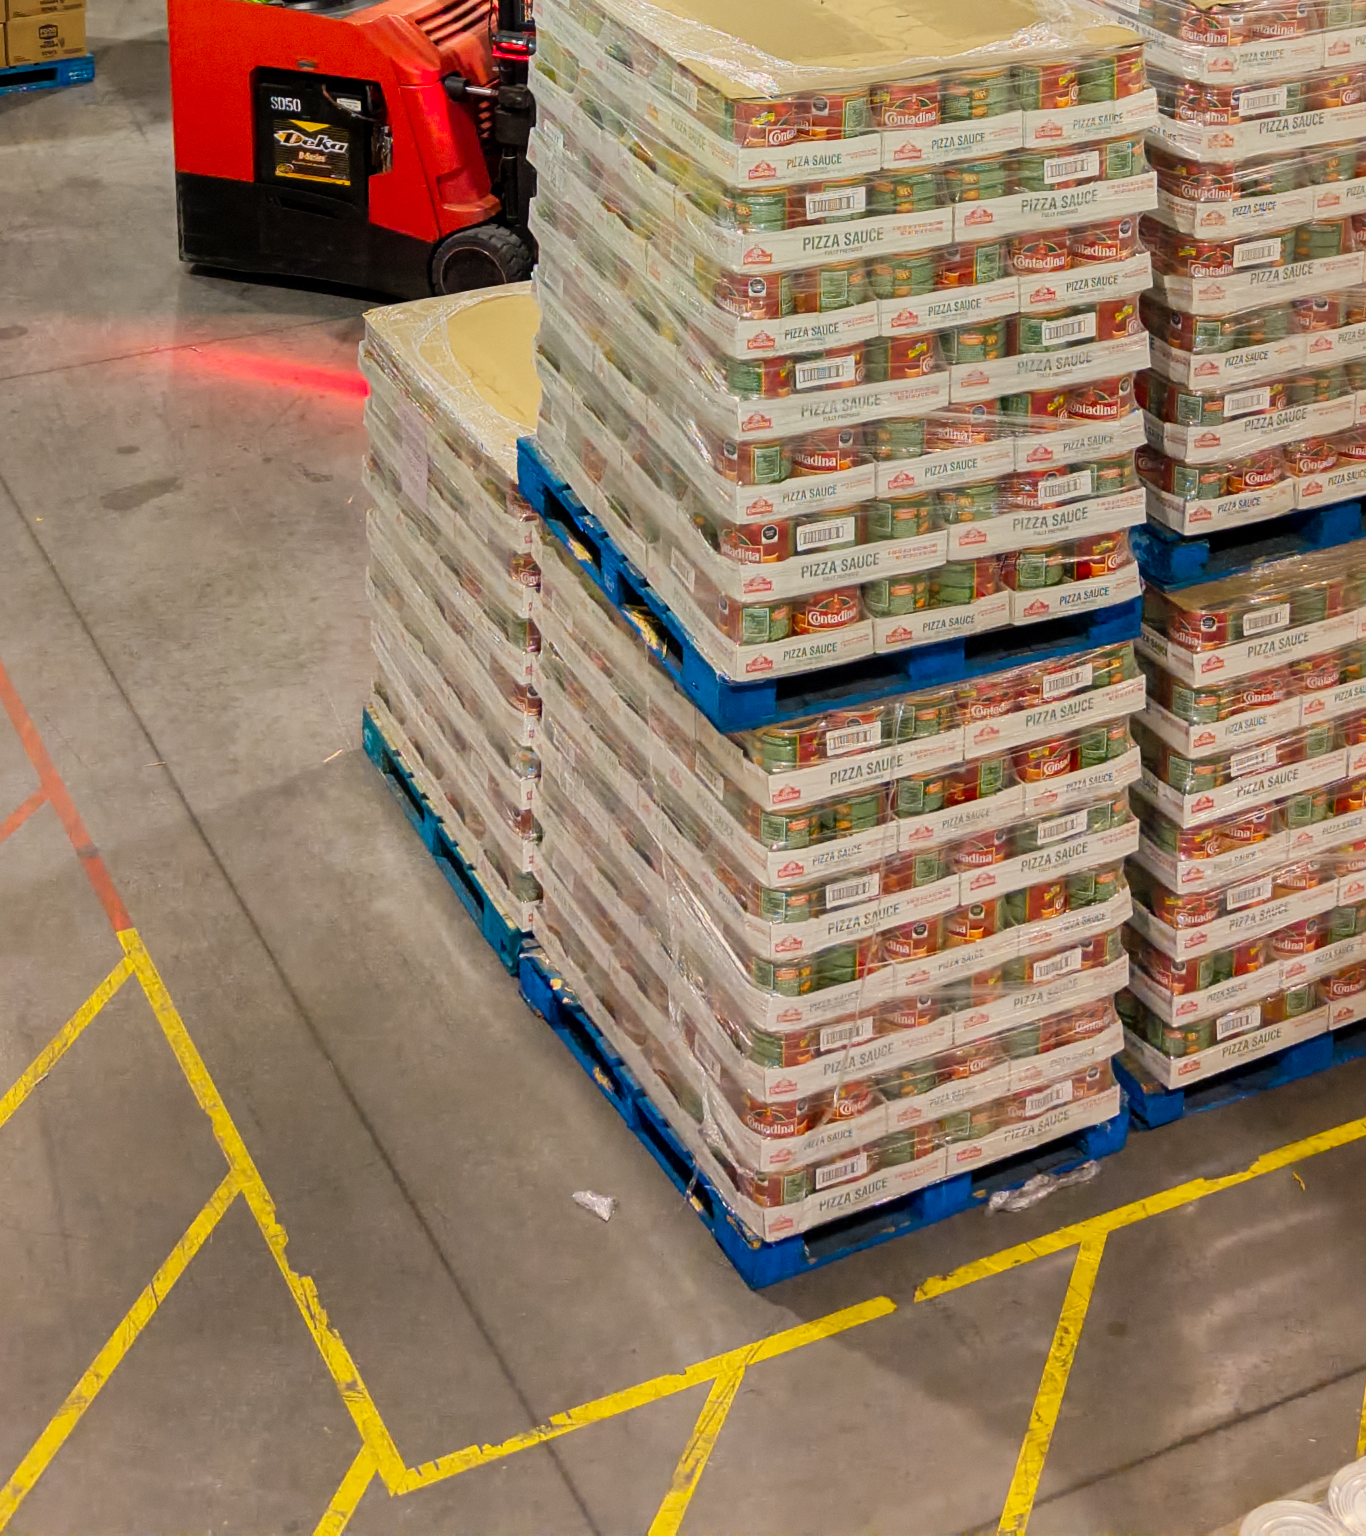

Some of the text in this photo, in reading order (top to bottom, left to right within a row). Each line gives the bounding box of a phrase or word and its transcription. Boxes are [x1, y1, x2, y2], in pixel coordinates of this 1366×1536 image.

[270, 95, 301, 112] SD50
[885, 111, 936, 126] Contadina
[1259, 112, 1324, 133] PIZZA SAUCE
[274, 129, 349, 153] Deka
[931, 132, 985, 150] PIZZA SAUCE
[787, 152, 842, 169] PIZZA SAUCE
[1021, 190, 1098, 212] PIZZA SAUCE
[803, 234, 840, 250] PIZZA
[844, 227, 884, 245] SAUCE
[1014, 254, 1065, 270] Contadina
[1066, 275, 1118, 291] PIZZA SAUCE
[1250, 263, 1313, 285] PIZZA SAUCE
[928, 298, 981, 316] PIZZA SAUCE
[785, 323, 839, 339] PIZZA SAUCE
[1244, 408, 1307, 431] PIZZA SAUCE
[924, 459, 978, 476] PIZZA SAUCE
[783, 484, 837, 503] PIZZA SAUCE
[1013, 507, 1088, 530] PIZZA SAUCE
[801, 553, 880, 579] PIZZA SAUCE
[1059, 586, 1110, 606] PIZZA SAUCE
[922, 614, 974, 632] PIZZA SAUCE
[783, 642, 838, 660] PIZZA SAUCE
[1247, 632, 1309, 658] PIZZA SAUCE
[1025, 698, 1094, 727] PIZZA SAUCE
[830, 754, 903, 785] PIZZA SAUCE
[1237, 769, 1299, 797] PIZZA SAUCE
[1222, 1029, 1281, 1057] PIZZA SAUCE
[747, 1115, 794, 1134] Contadina
[819, 1178, 888, 1210] PIZZA SAUCE
